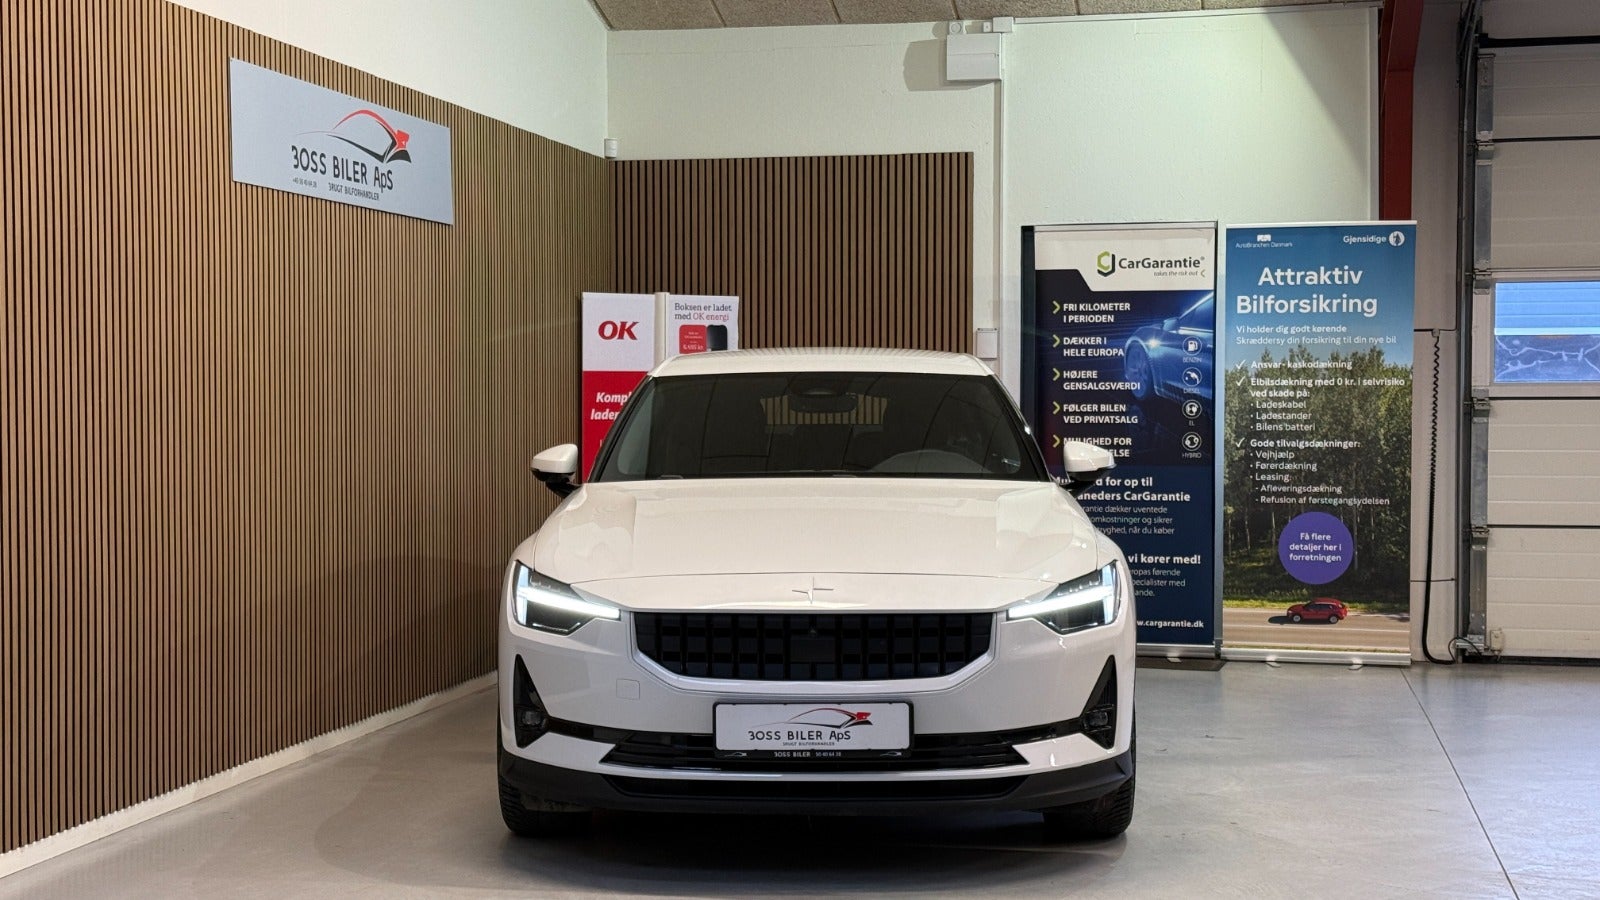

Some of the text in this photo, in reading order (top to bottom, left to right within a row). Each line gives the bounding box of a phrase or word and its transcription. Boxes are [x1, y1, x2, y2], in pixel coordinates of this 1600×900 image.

[333, 155, 368, 186] BILER
[373, 165, 393, 193] ApS
[344, 185, 380, 202] BILFORHANDLER
[1343, 235, 1386, 244] Gjensidige
[1258, 265, 1363, 286] Attraktiv
[674, 303, 702, 311] Boksen
[712, 304, 732, 312] ladet
[1063, 303, 1131, 312] FRI KILOMETER
[1236, 293, 1378, 318] Bilforsikring
[674, 312, 730, 322] med OK energi
[1068, 315, 1114, 323] PERIODEN
[597, 320, 640, 341] OK
[1236, 325, 1347, 335] Vi holder dig godt kørende
[1063, 337, 1102, 345] DÆKKER
[1236, 336, 1397, 346] Skræddersy din forsikring til din nye bil
[1063, 348, 1125, 357] HELE EUROPA
[1287, 361, 1353, 370] kaskodækning
[1063, 370, 1098, 379] HØJERE
[1063, 382, 1141, 391] GENSALGSVÆRDI
[1251, 378, 1313, 388] Elbilsdækning
[1315, 378, 1335, 386] med
[1337, 378, 1343, 386] 0
[1345, 378, 1356, 386] kr.
[1362, 378, 1406, 386] selvrisiko
[1251, 389, 1310, 399] ved skade på:
[1063, 403, 1126, 412] FØLGER BILEN
[1256, 400, 1307, 409] Ladeskabel
[1063, 415, 1139, 424] VED PRIVATSALG
[1256, 411, 1312, 420] Ladestander
[1256, 422, 1315, 431] Bilens batteri
[1113, 437, 1132, 446] FOR
[1250, 439, 1361, 449] Gode tilvalgsdækninger:
[1255, 450, 1295, 460] Vejhjælp
[1255, 461, 1318, 472] Førerdækning
[1105, 477, 1121, 486] for
[1124, 479, 1139, 488] op
[1141, 477, 1153, 486] til
[1260, 484, 1343, 494] Afleveringsdækning
[1123, 492, 1191, 501] CarGarantie
[1260, 496, 1391, 506] Refusion af førstegangsydelsen
[1105, 505, 1132, 513] dækker
[1133, 505, 1168, 513] uventede
[1141, 517, 1152, 525] og
[1153, 516, 1173, 524] sikrer
[1128, 526, 1141, 534] når
[1143, 526, 1153, 534] du
[1154, 526, 1175, 535] køber
[1300, 532, 1332, 541] Få flere
[1289, 542, 1321, 553] detaljer
[1323, 542, 1337, 551] her
[1128, 554, 1201, 565] vi kører med!
[1289, 553, 1342, 563] forretningen
[1152, 568, 1181, 577] førende
[1131, 578, 1186, 588] pecialister med
[787, 731, 823, 741] BILER
[829, 731, 851, 742] ApS
